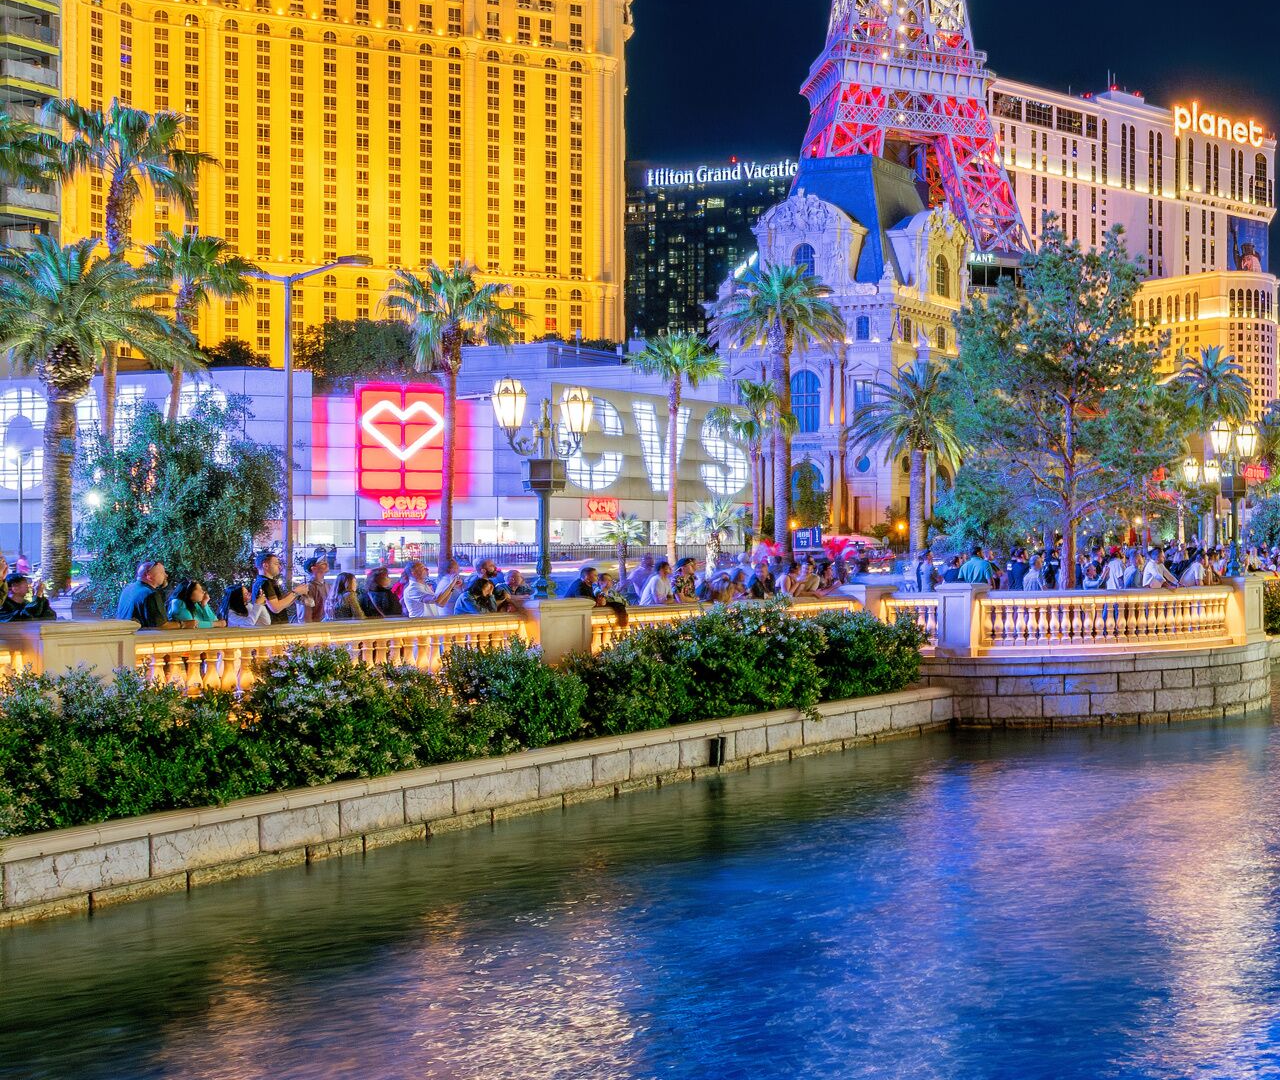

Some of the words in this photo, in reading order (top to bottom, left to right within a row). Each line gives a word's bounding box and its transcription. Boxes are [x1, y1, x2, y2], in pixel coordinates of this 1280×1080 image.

[1174, 101, 1264, 148] planet
[647, 167, 694, 187] Hilton
[697, 162, 741, 183] Grand
[558, 397, 749, 496] CVS
[395, 496, 427, 510] CVS
[597, 501, 617, 513] CVS
[382, 509, 426, 519] pharmacy
